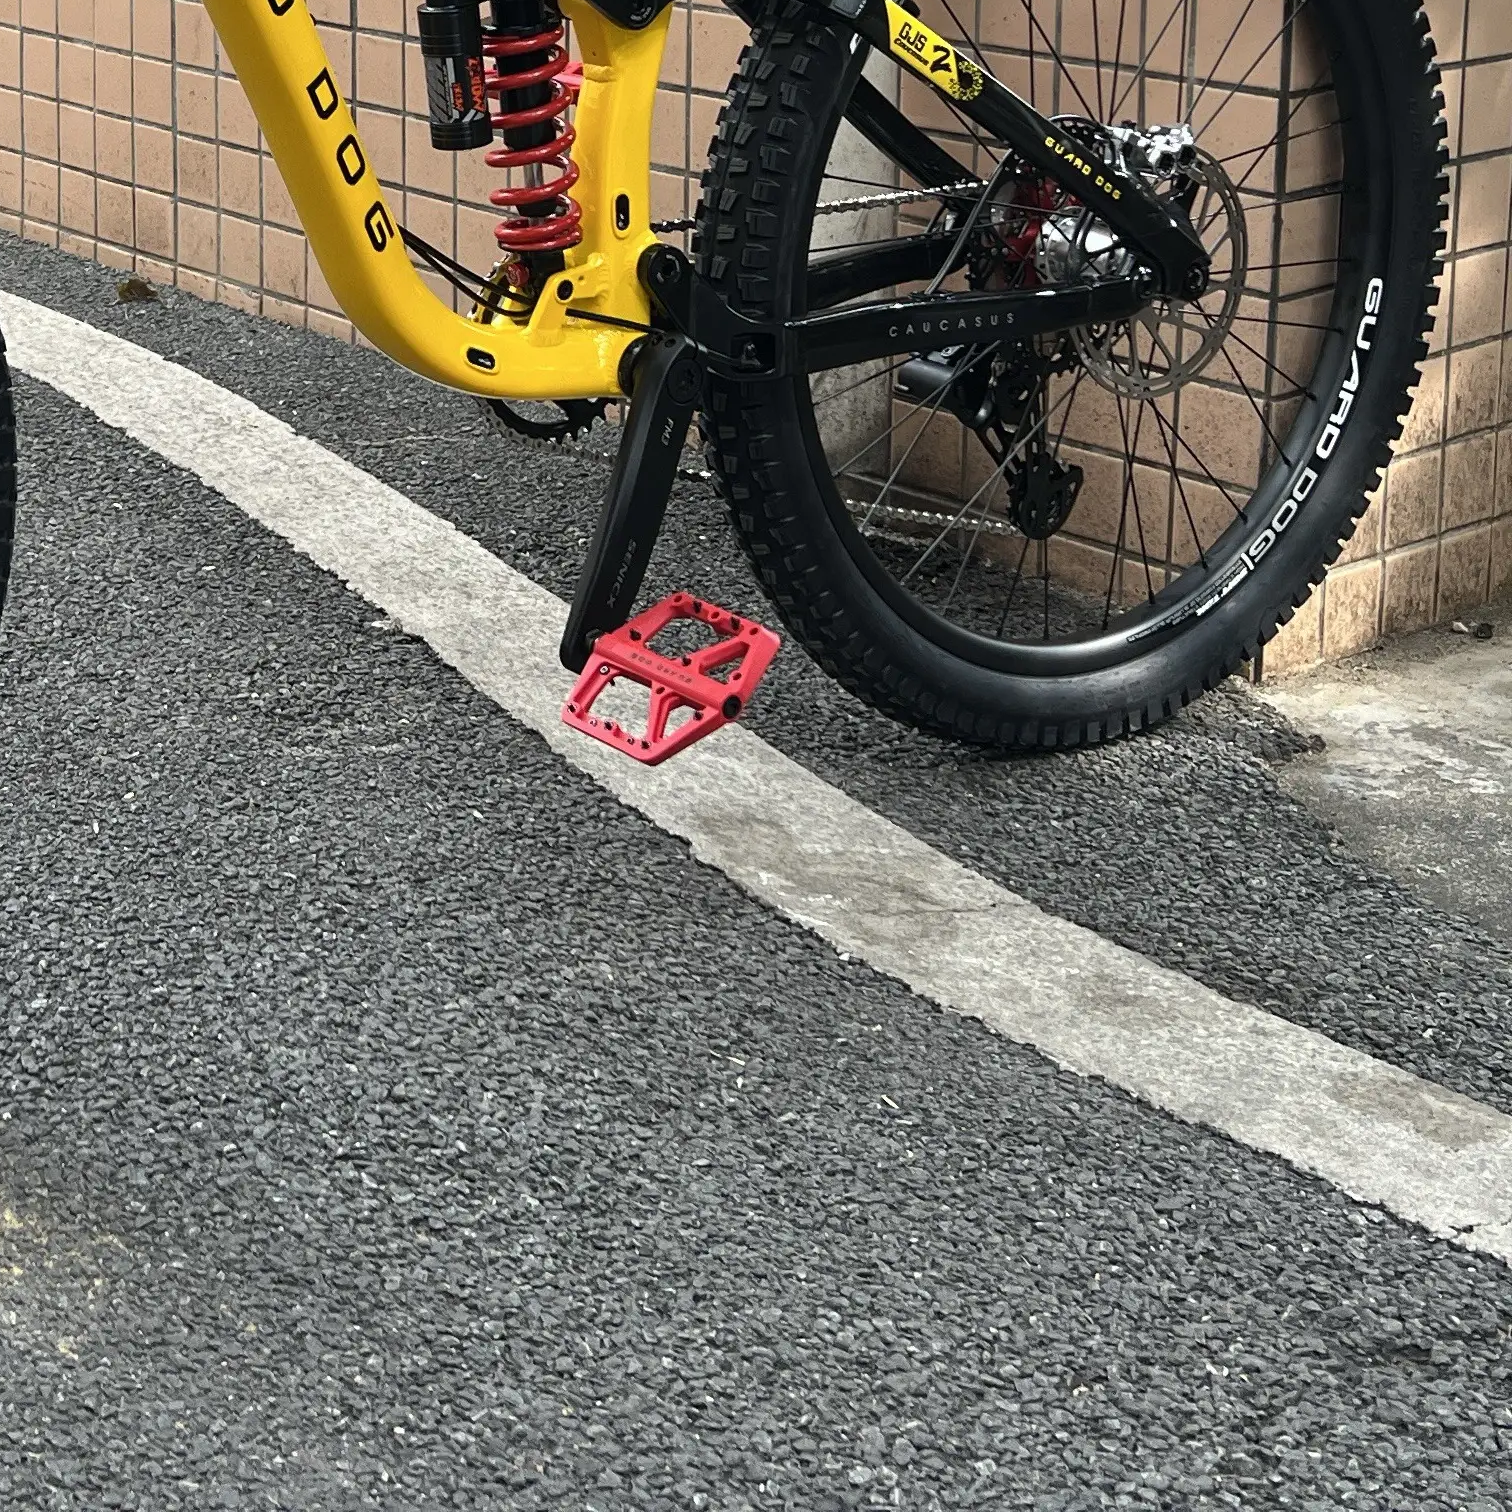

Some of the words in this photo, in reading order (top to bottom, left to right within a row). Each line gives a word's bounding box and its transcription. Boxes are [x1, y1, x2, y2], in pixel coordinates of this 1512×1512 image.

[930, 45, 952, 73] 2
[306, 67, 396, 253] DOG
[1044, 136, 1093, 177] GUARD
[1094, 174, 1121, 201] DOG
[889, 312, 1015, 337] CAUCASUS
[1315, 277, 1383, 460] GUARD
[1251, 466, 1319, 563] DOG
